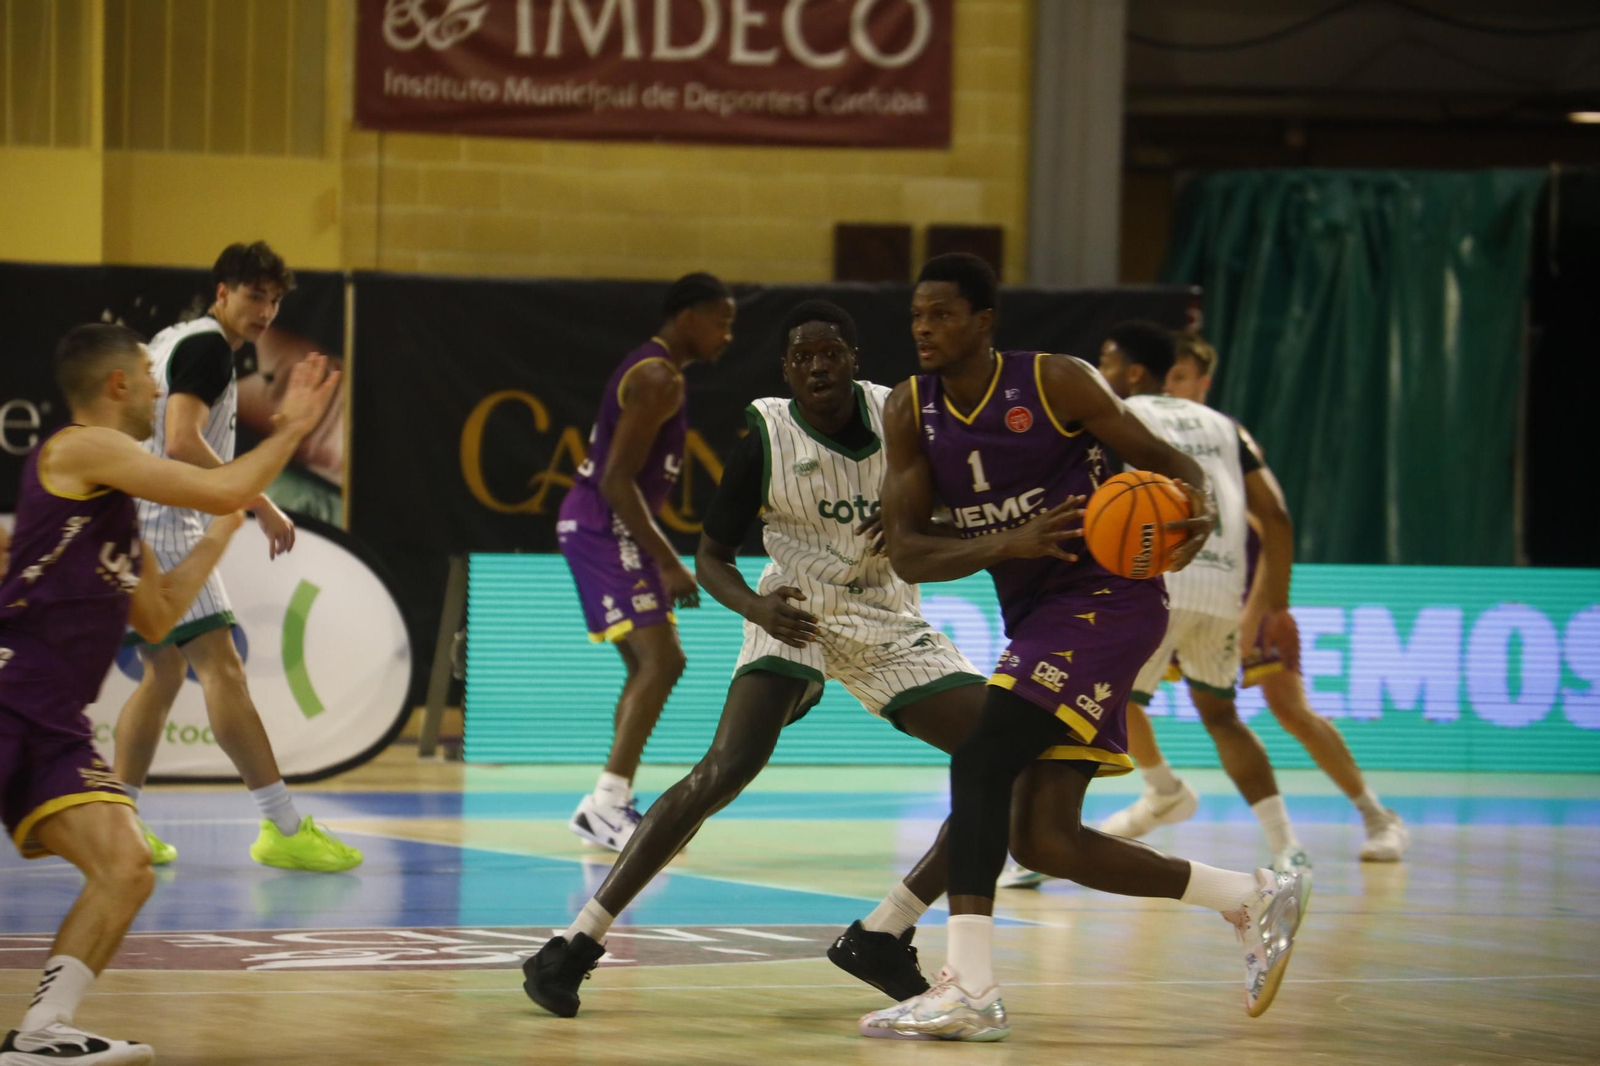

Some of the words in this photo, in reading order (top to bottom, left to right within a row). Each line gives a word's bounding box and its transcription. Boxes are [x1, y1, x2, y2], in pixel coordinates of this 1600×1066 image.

[515, 0, 933, 69] IMDECO
[383, 68, 501, 104] Instituto
[503, 77, 636, 110] Municipal
[641, 82, 679, 110] de
[683, 81, 809, 117] Deportes
[967, 450, 991, 493] 1
[1131, 522, 1157, 578] Wilson
[1033, 660, 1070, 688] CBC
